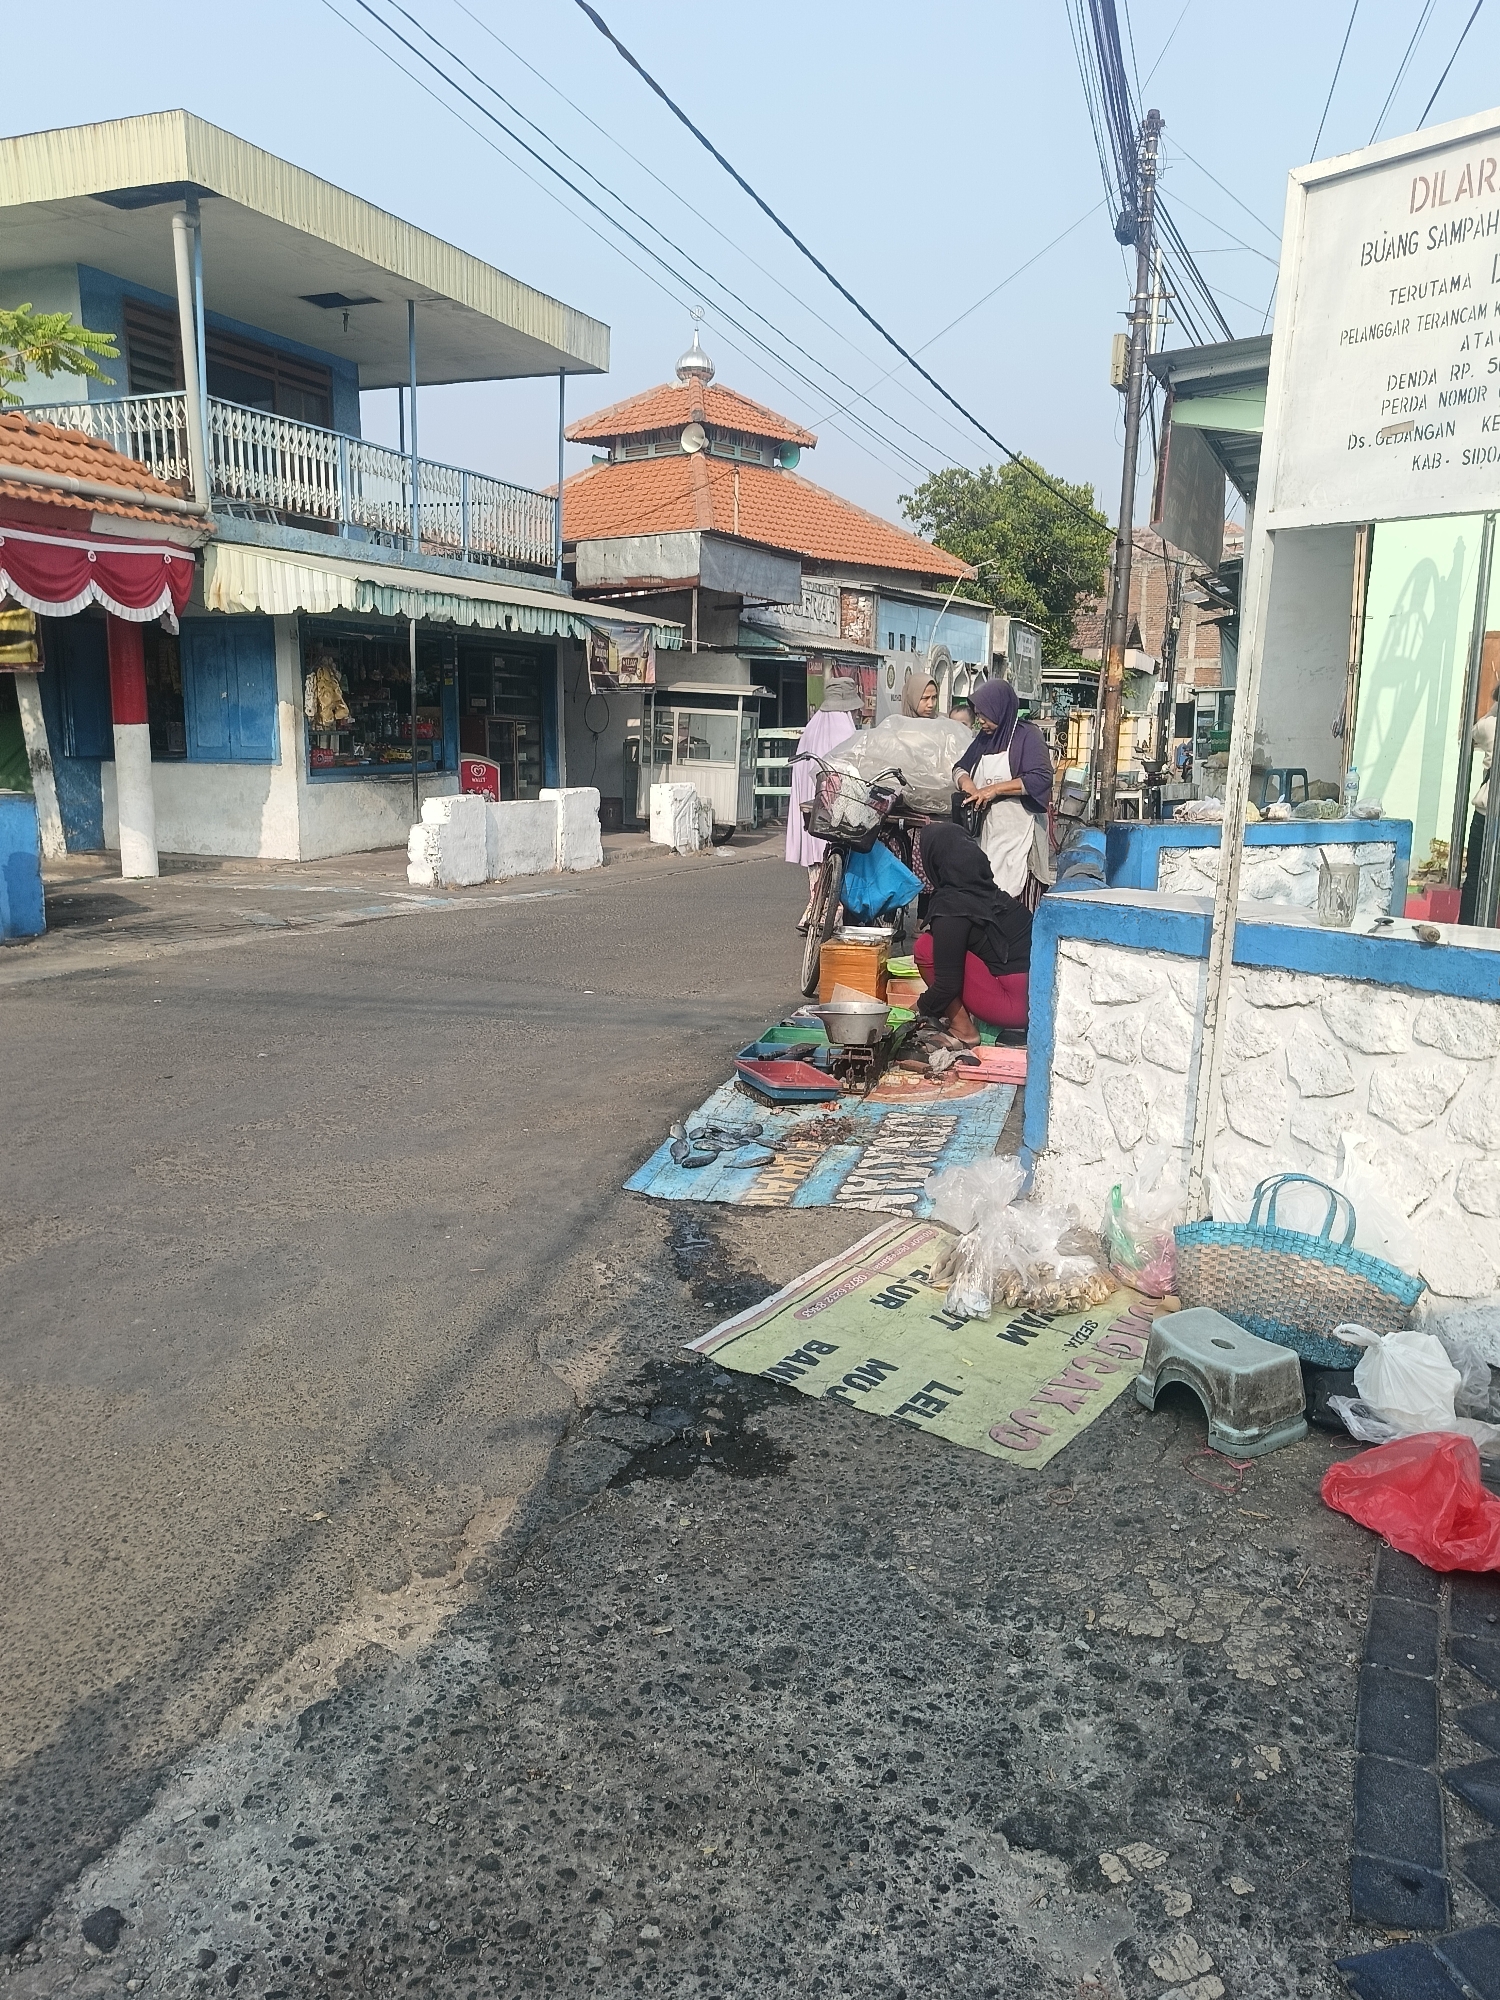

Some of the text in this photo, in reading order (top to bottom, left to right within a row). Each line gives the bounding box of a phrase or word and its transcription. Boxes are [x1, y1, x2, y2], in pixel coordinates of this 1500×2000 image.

[1409, 157, 1500, 214] DILAR
[1361, 208, 1500, 267] BUANG SAMPAH
[1389, 272, 1472, 306] TERUTAMA
[1340, 318, 1411, 346] PELANGGAR
[1417, 302, 1488, 332] TERANCAM
[1460, 330, 1500, 351] ATA
[1387, 368, 1438, 391] DENDA
[1450, 362, 1474, 381] RP.
[1381, 385, 1488, 416] PERDA NOMOR
[1461, 446, 1500, 466] SIDO
[844, 1273, 868, 1291] 0878
[1030, 1356, 1121, 1415] CAK
[988, 1408, 1056, 1452] JO
